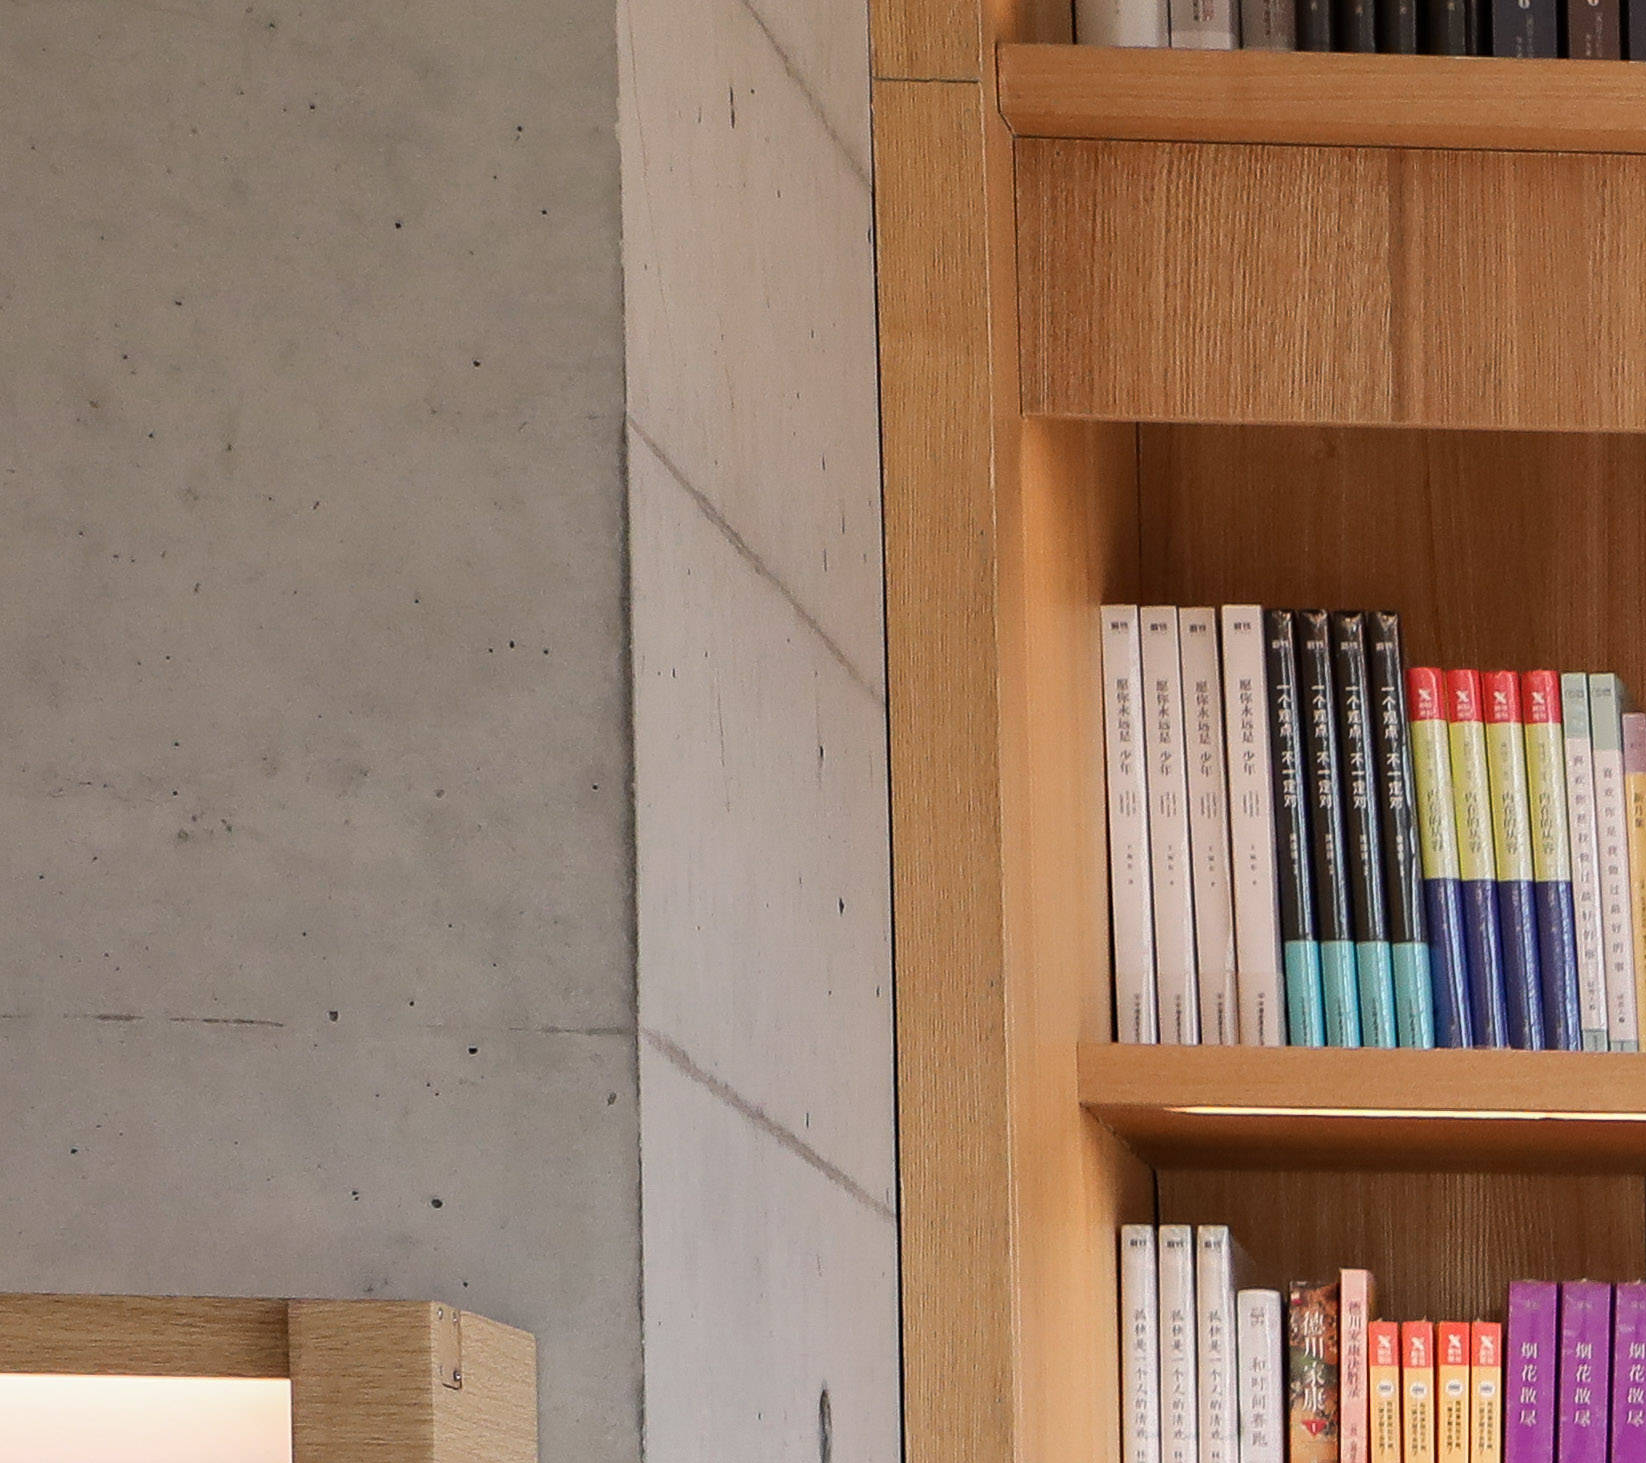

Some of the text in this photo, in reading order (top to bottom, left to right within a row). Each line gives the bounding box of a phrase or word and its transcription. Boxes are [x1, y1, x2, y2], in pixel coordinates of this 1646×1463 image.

[1250, 1355, 1268, 1447] 和时间赛跑
[1301, 1310, 1325, 1413] 德川家康
